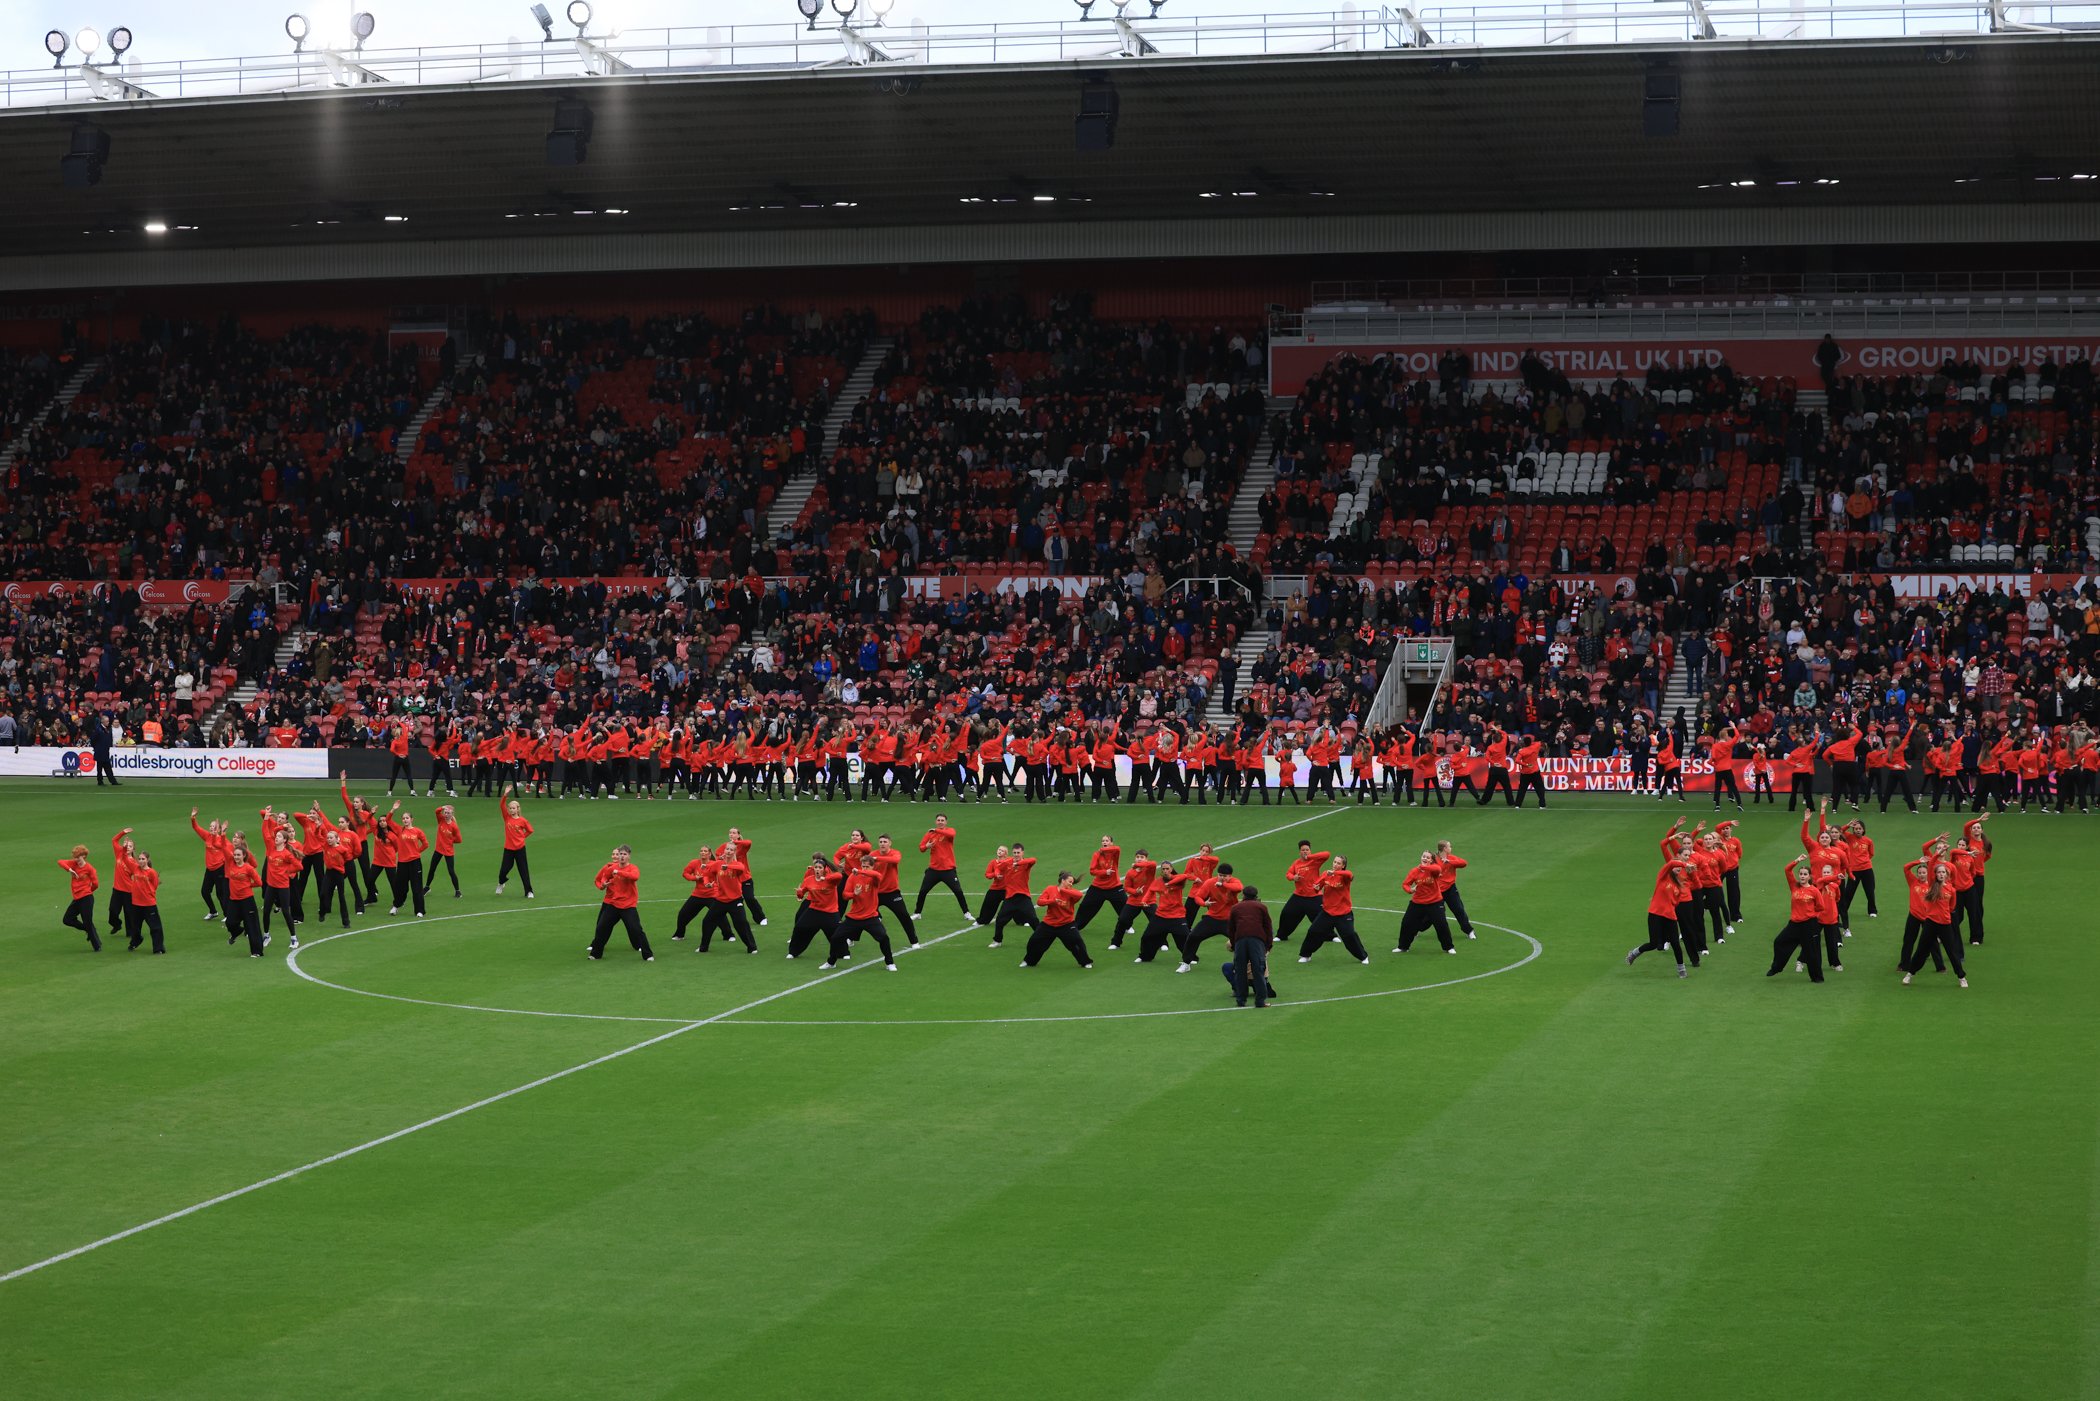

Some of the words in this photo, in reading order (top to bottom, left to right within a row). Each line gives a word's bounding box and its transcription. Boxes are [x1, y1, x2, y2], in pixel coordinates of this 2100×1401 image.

[1474, 350, 1629, 372] INDSTRIAL
[1635, 349, 1670, 370] UK
[1859, 347, 1957, 368] GROUP
[66, 757, 76, 767] M
[82, 757, 89, 767] C
[111, 754, 212, 773] iddlesbrough
[217, 756, 276, 775] College
[1619, 758, 1715, 775] BSESS
